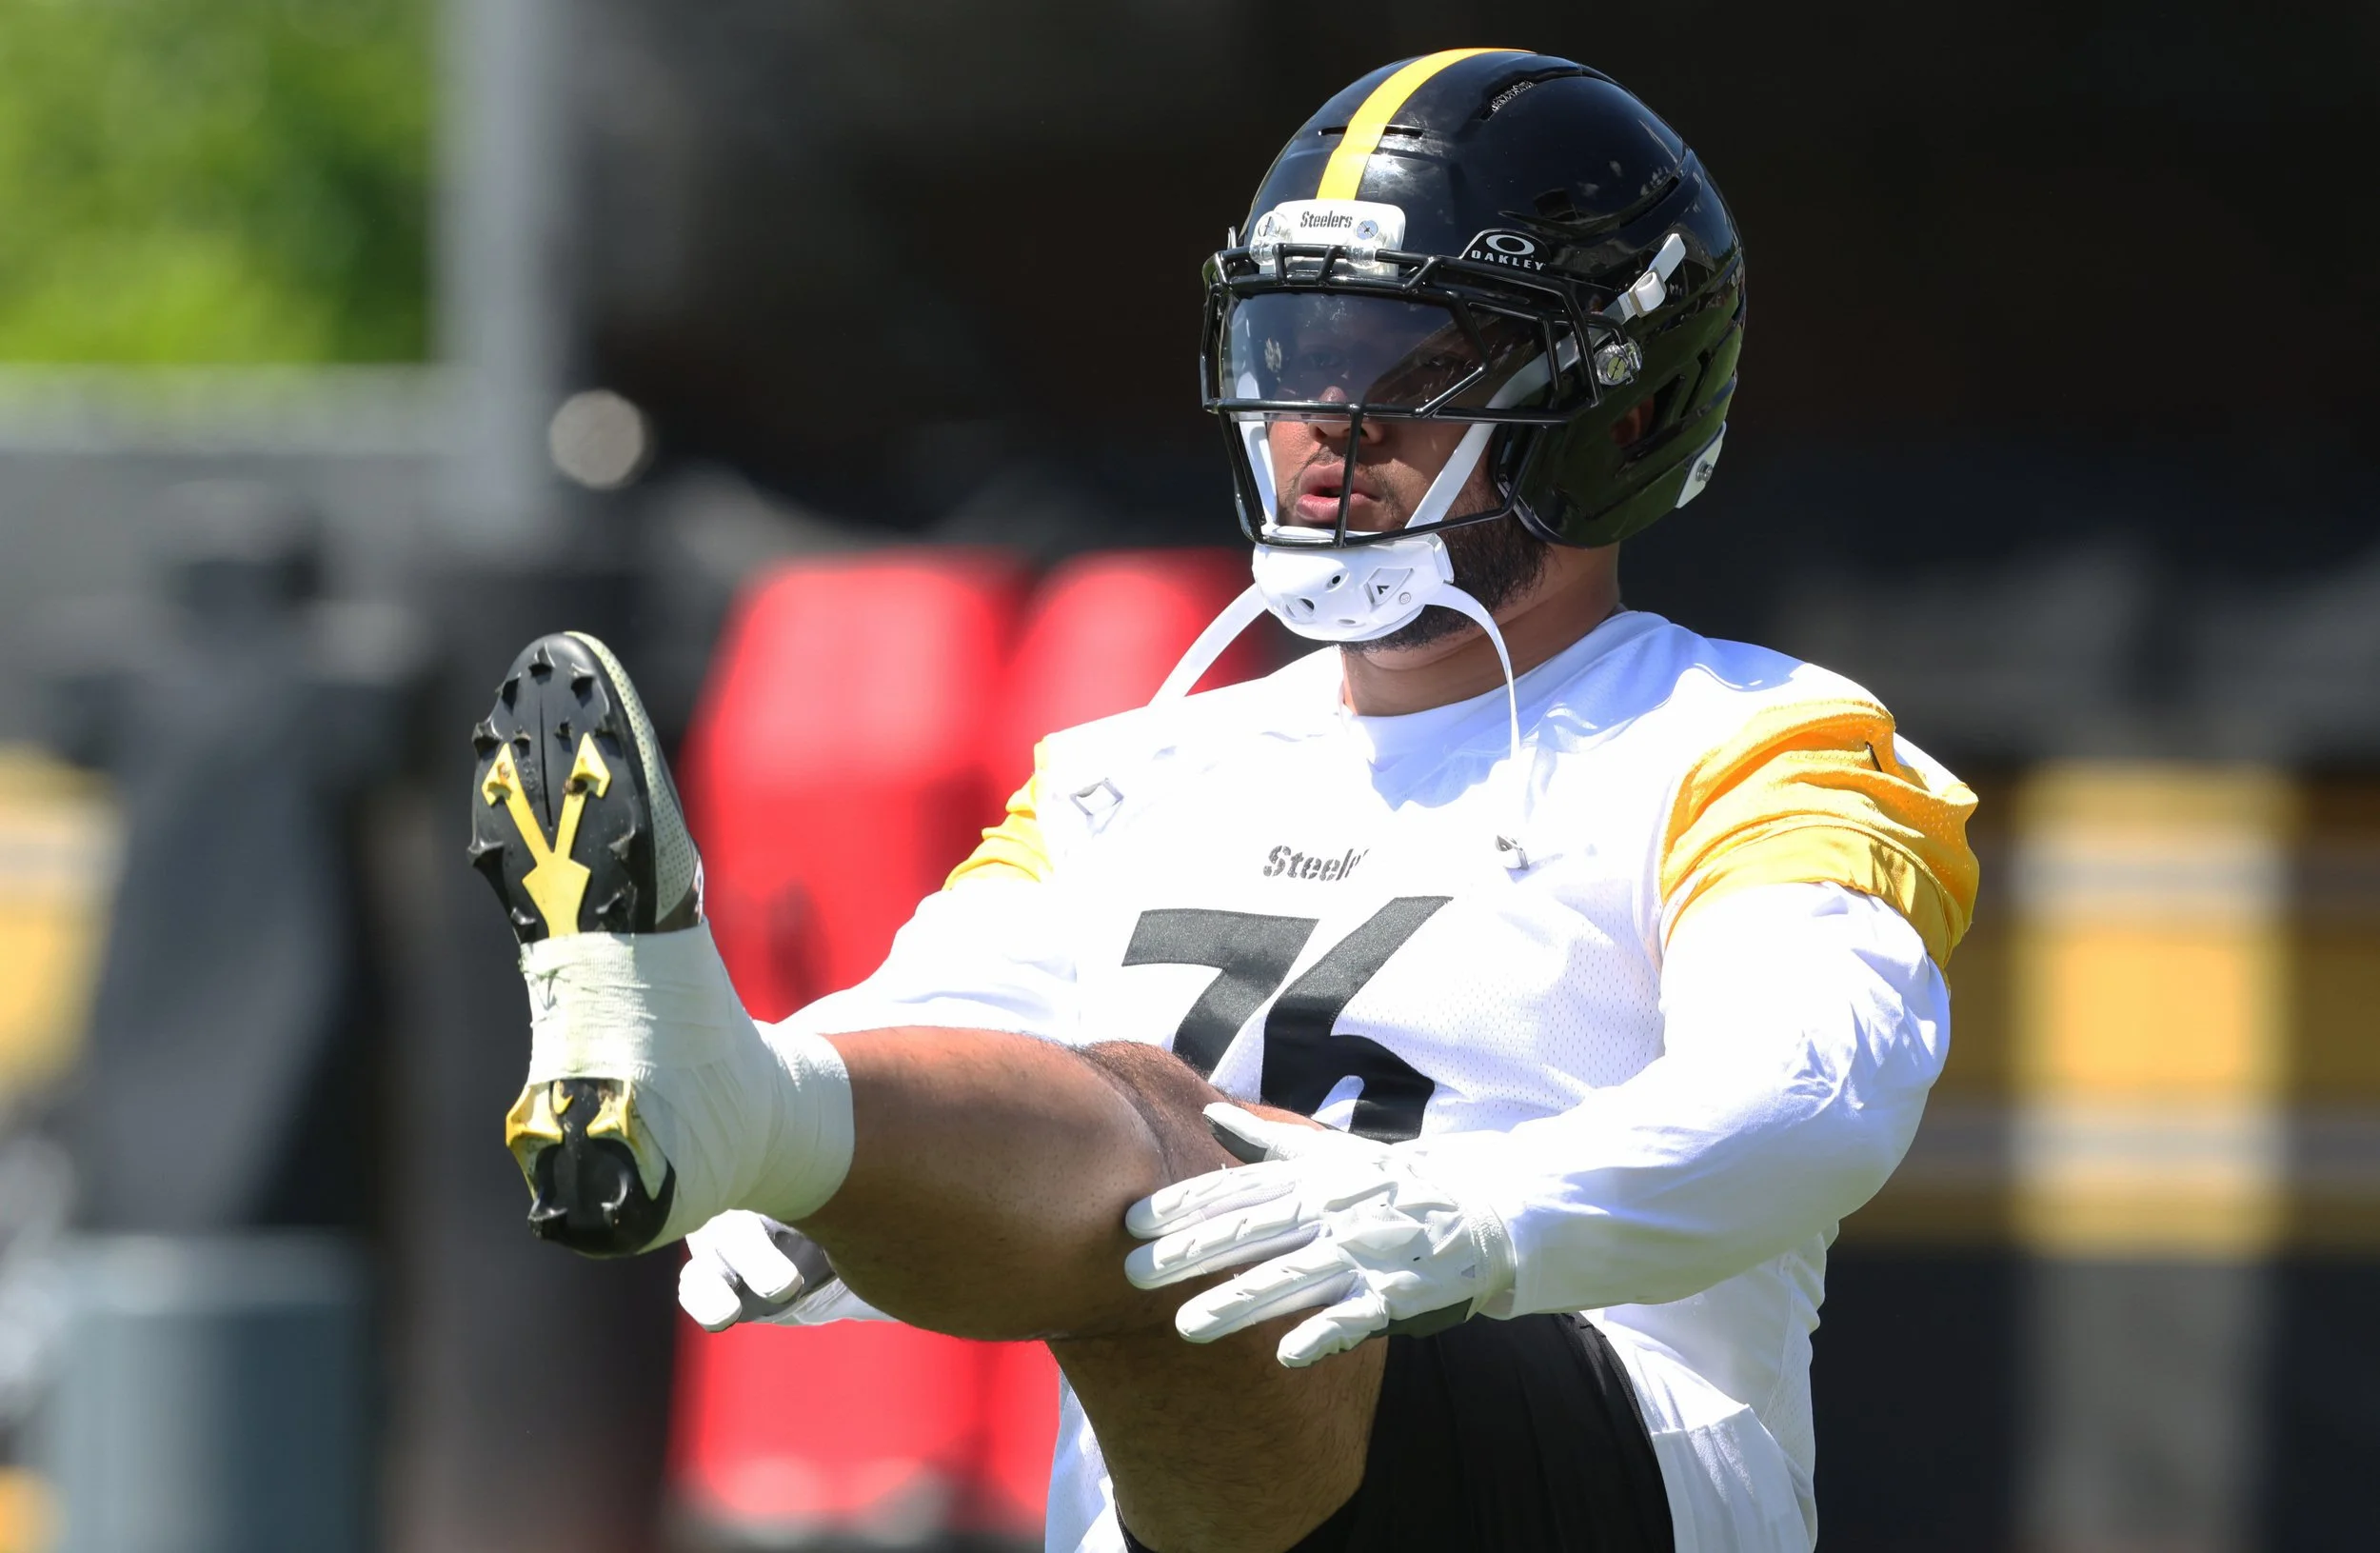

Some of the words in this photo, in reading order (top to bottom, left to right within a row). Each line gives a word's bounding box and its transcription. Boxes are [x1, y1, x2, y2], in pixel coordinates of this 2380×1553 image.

[1299, 210, 1353, 229] Steelers
[1471, 249, 1544, 271] OAKLEY
[1121, 895, 1454, 1145] 76
